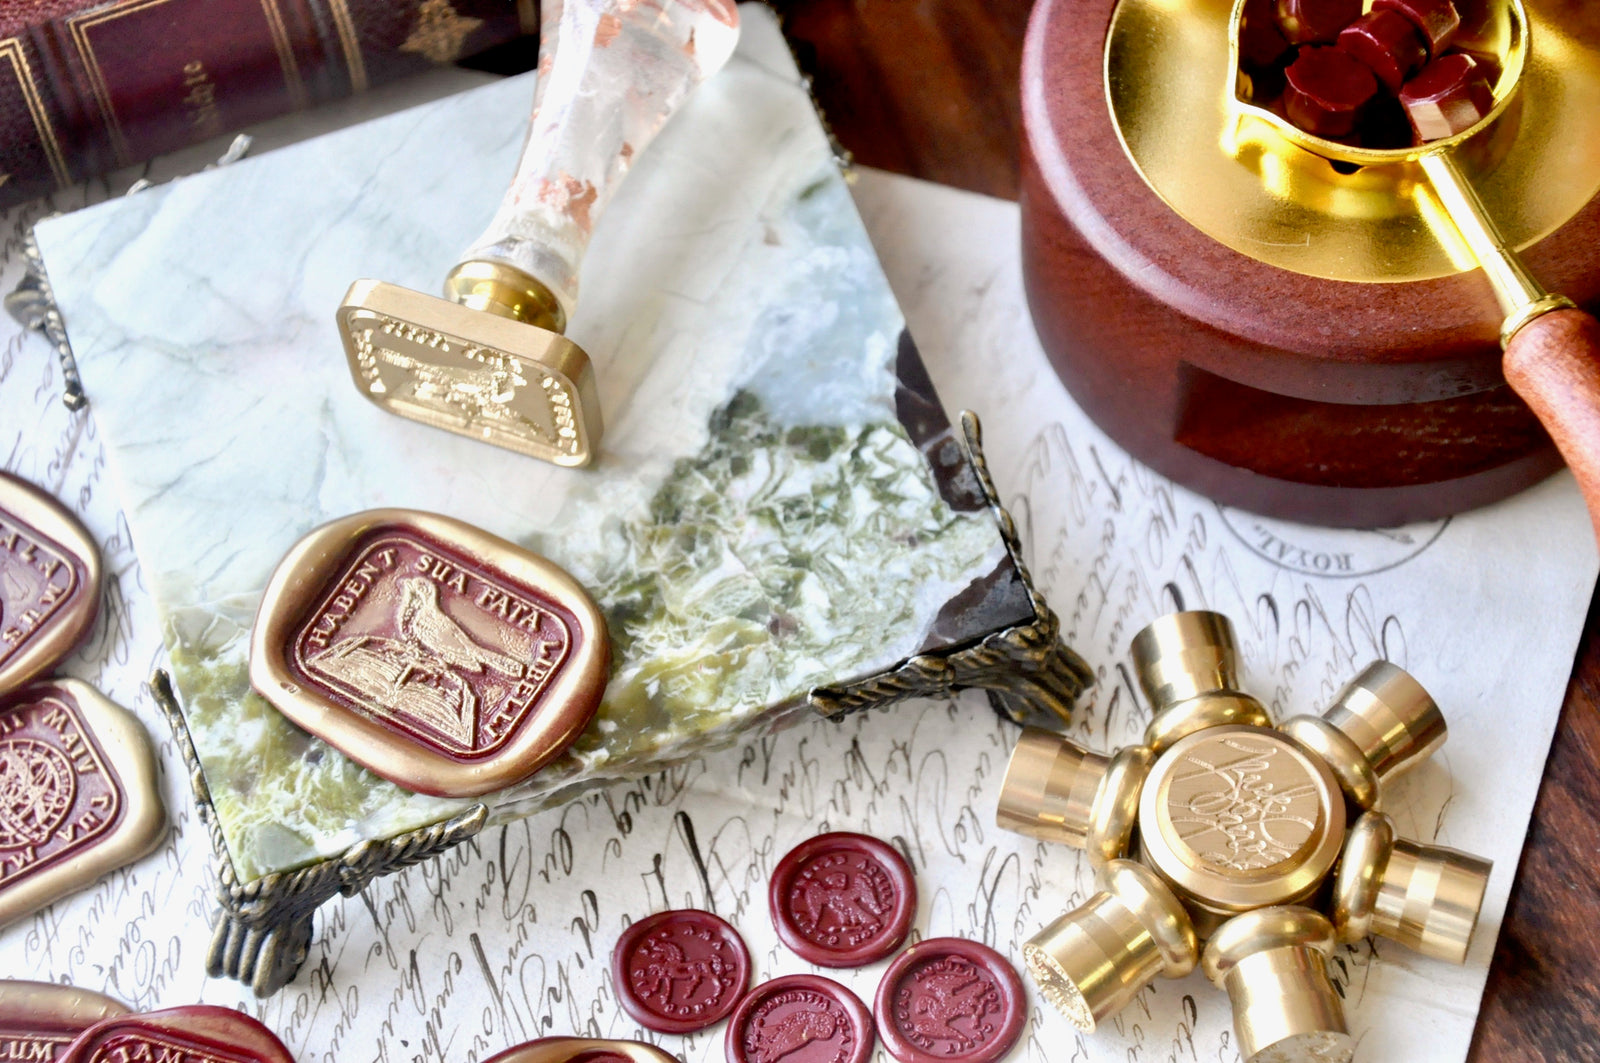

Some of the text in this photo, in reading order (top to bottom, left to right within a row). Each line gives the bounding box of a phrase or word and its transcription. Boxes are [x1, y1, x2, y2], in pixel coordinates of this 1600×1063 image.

[308, 548, 564, 743] HABENT SUA FATA LIBELLI
